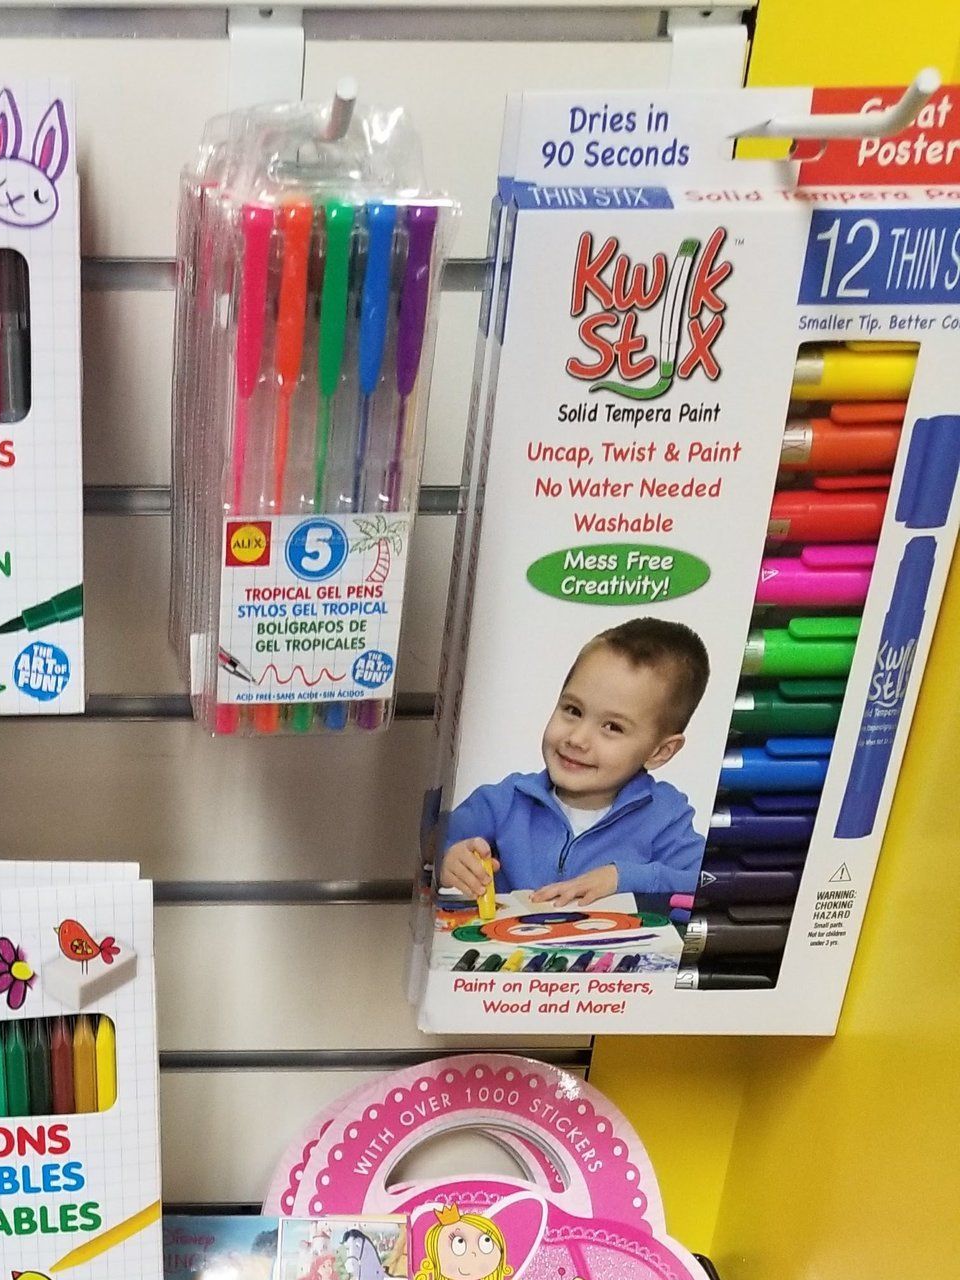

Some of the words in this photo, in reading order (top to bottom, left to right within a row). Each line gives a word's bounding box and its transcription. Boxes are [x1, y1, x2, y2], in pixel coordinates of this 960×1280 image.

[569, 105, 637, 134] Dries
[647, 103, 669, 132] in
[542, 141, 573, 169] 90
[584, 140, 690, 168] Seconds
[529, 187, 588, 206] THIN
[593, 187, 649, 206] STIX
[817, 218, 880, 298] 12
[886, 227, 946, 290] THIN
[798, 315, 853, 330] Smaller
[859, 314, 882, 334] Tip.
[889, 314, 936, 330] Better
[557, 403, 598, 423] Solid
[605, 404, 672, 427] Tempera
[678, 404, 721, 422] Paint
[527, 441, 594, 466] Uncap,
[601, 441, 657, 462] Twist
[664, 443, 680, 462] &
[688, 441, 742, 462] Paint
[535, 478, 562, 497] No
[569, 478, 633, 497] Water
[640, 477, 721, 497] Needed
[574, 513, 674, 532] Washable
[301, 527, 333, 571] 5
[563, 551, 618, 571] Mess
[627, 551, 674, 570] Free
[245, 587, 311, 601] TROPICAL
[317, 586, 341, 600] GEL
[347, 585, 383, 599] PENS
[561, 575, 670, 600] Creativity!
[238, 604, 286, 618] STYLOS
[292, 603, 317, 617] GEL
[323, 602, 388, 615] TROPICAL
[257, 618, 344, 635] BOLÍGRAFOS
[350, 620, 367, 632] DE
[255, 640, 280, 653] GEL
[285, 637, 366, 651] TROPICALES
[816, 890, 857, 900] WARNING:
[815, 900, 854, 910] CHOKING
[812, 910, 851, 920] HAZARD
[453, 979, 496, 994] Paint
[501, 981, 523, 994] on
[529, 979, 581, 998] Paper,
[587, 979, 654, 996] Posters,
[482, 999, 531, 1016] Wood
[537, 1000, 570, 1015] and
[576, 999, 626, 1015] More!
[352, 1128, 395, 1177] WITH
[399, 1092, 452, 1126] OVER
[464, 1087, 519, 1106] 1000
[529, 1098, 603, 1173] STICKERS
